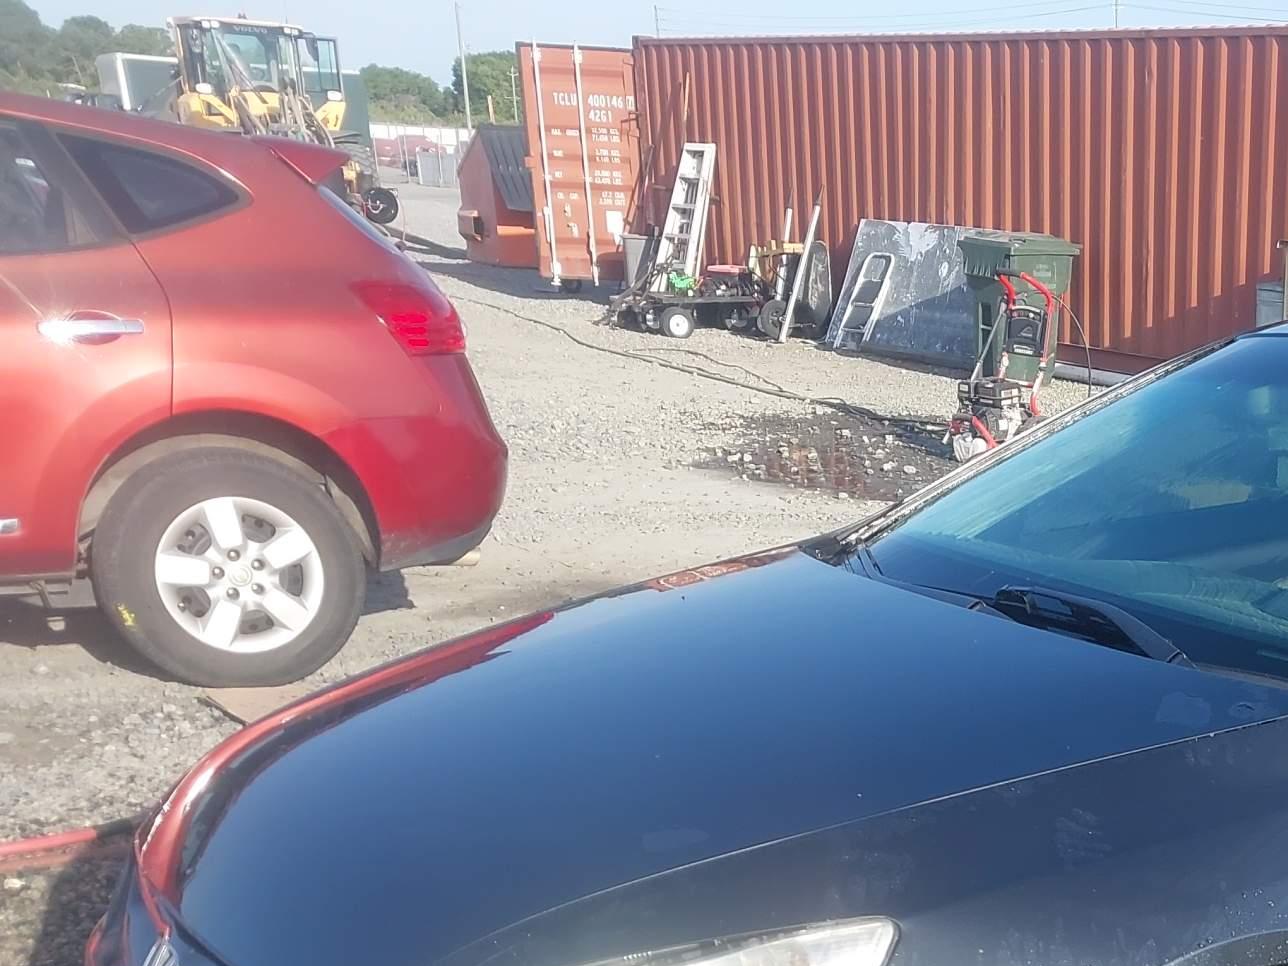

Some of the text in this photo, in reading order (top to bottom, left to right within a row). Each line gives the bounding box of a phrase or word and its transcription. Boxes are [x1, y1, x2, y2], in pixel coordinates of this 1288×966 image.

[233, 25, 268, 33] VOLVO
[552, 92, 577, 106] TCLU
[588, 94, 624, 109] 400146
